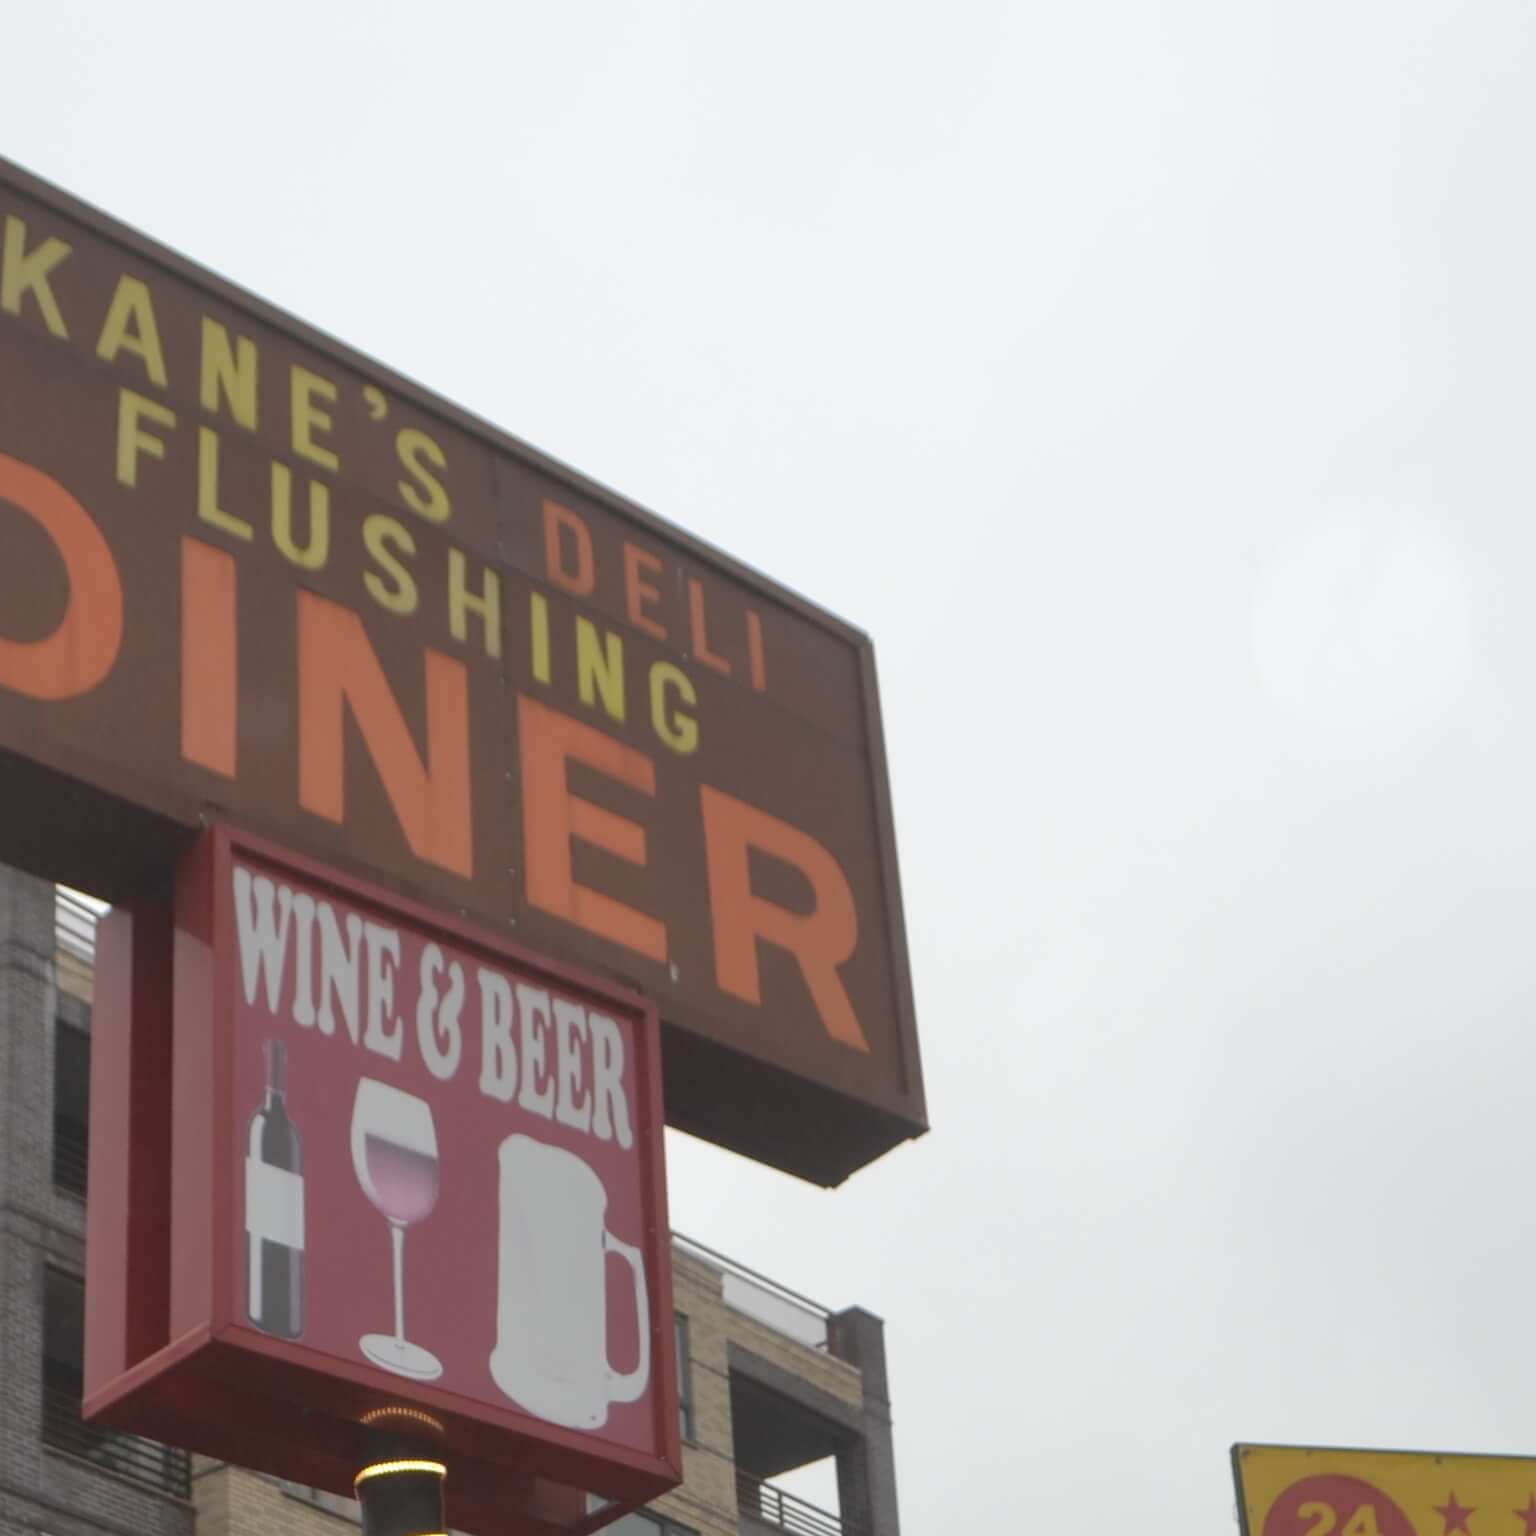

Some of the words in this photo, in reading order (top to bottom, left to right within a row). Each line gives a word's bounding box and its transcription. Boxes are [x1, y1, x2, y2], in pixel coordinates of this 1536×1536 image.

[0, 214, 451, 526] KANE'S
[115, 387, 700, 754] FLUSHING
[540, 499, 768, 692] DELI
[233, 865, 404, 1061] WINE
[417, 942, 466, 1081] &
[477, 969, 634, 1150] BEER
